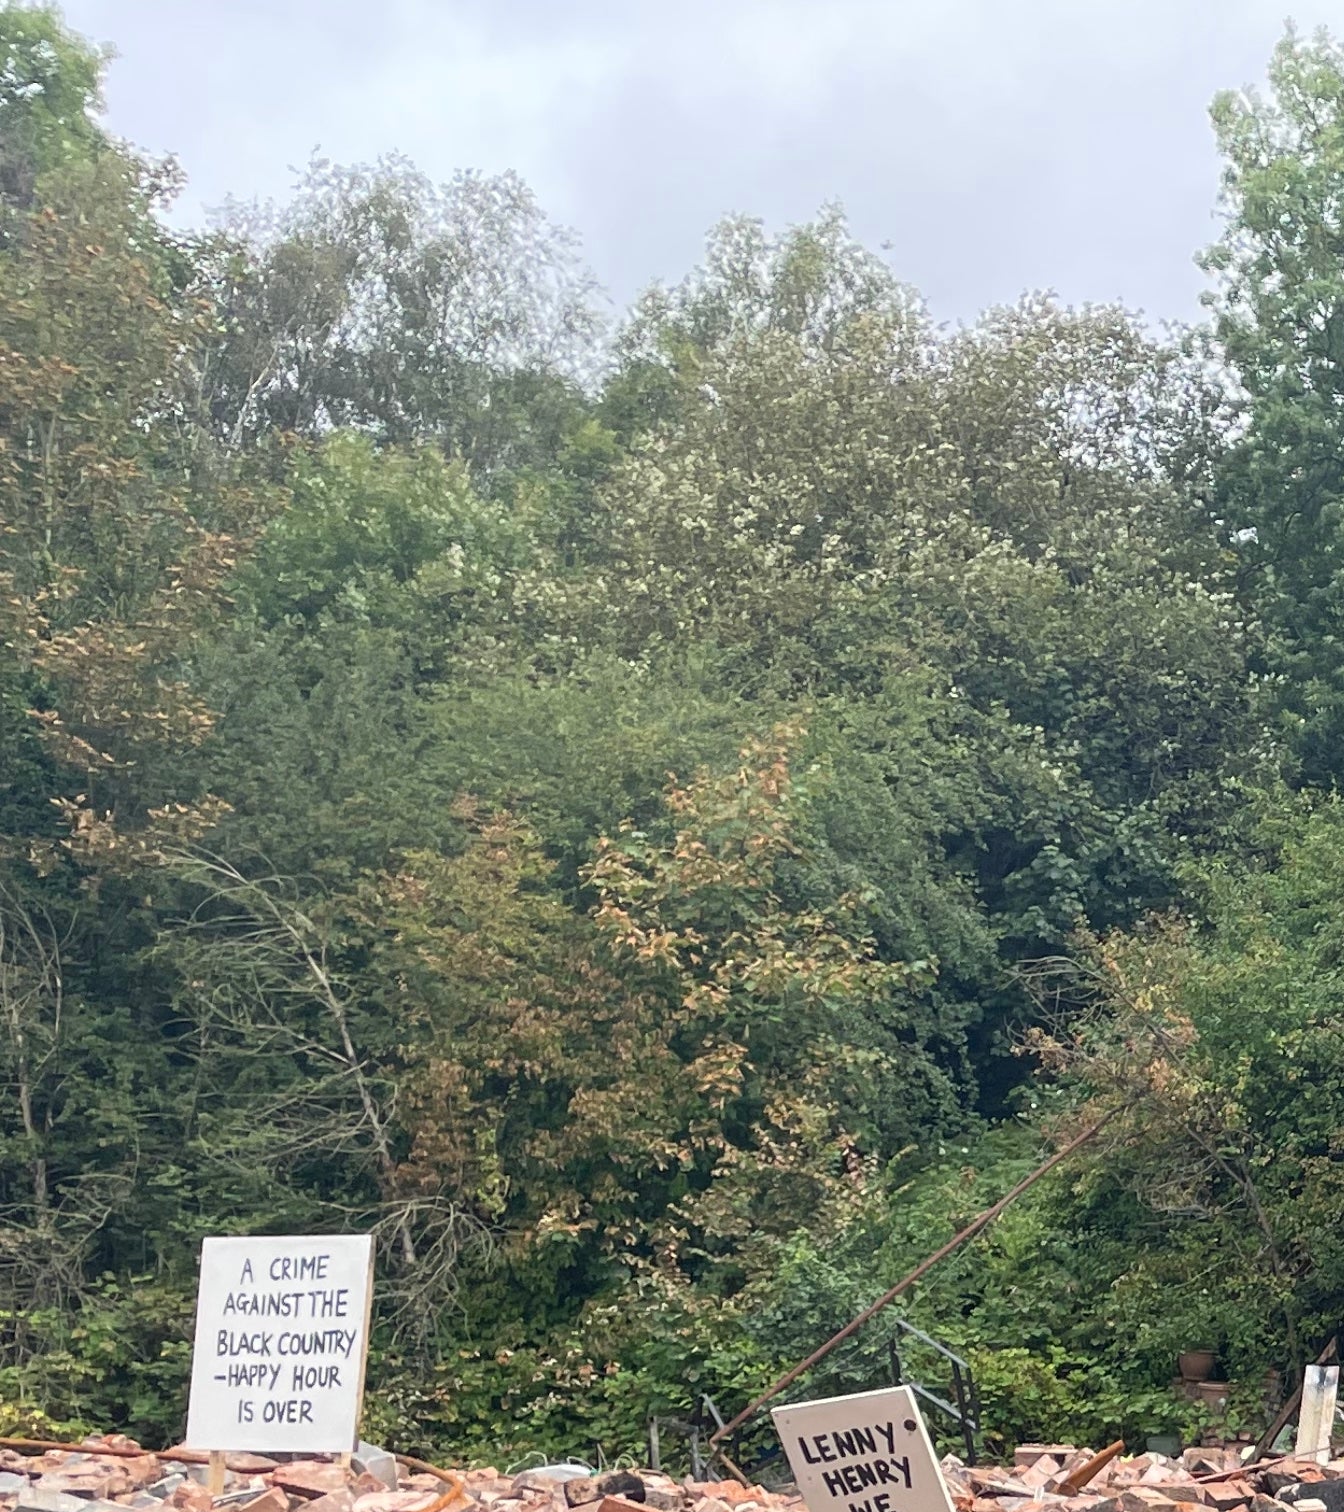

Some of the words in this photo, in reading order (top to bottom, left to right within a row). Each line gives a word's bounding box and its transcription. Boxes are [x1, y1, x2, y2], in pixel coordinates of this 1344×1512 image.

[240, 1258, 253, 1285] A
[269, 1255, 330, 1281] CRIME
[223, 1291, 304, 1317] AGAINST
[308, 1289, 348, 1317] THE
[217, 1330, 273, 1357] BLACK
[278, 1329, 357, 1358] COUNTRY
[292, 1365, 341, 1391] HOUR
[238, 1400, 253, 1423] IS
[263, 1400, 313, 1423] OVER
[799, 1421, 895, 1464] LENNY
[822, 1456, 912, 1497] HENRY
